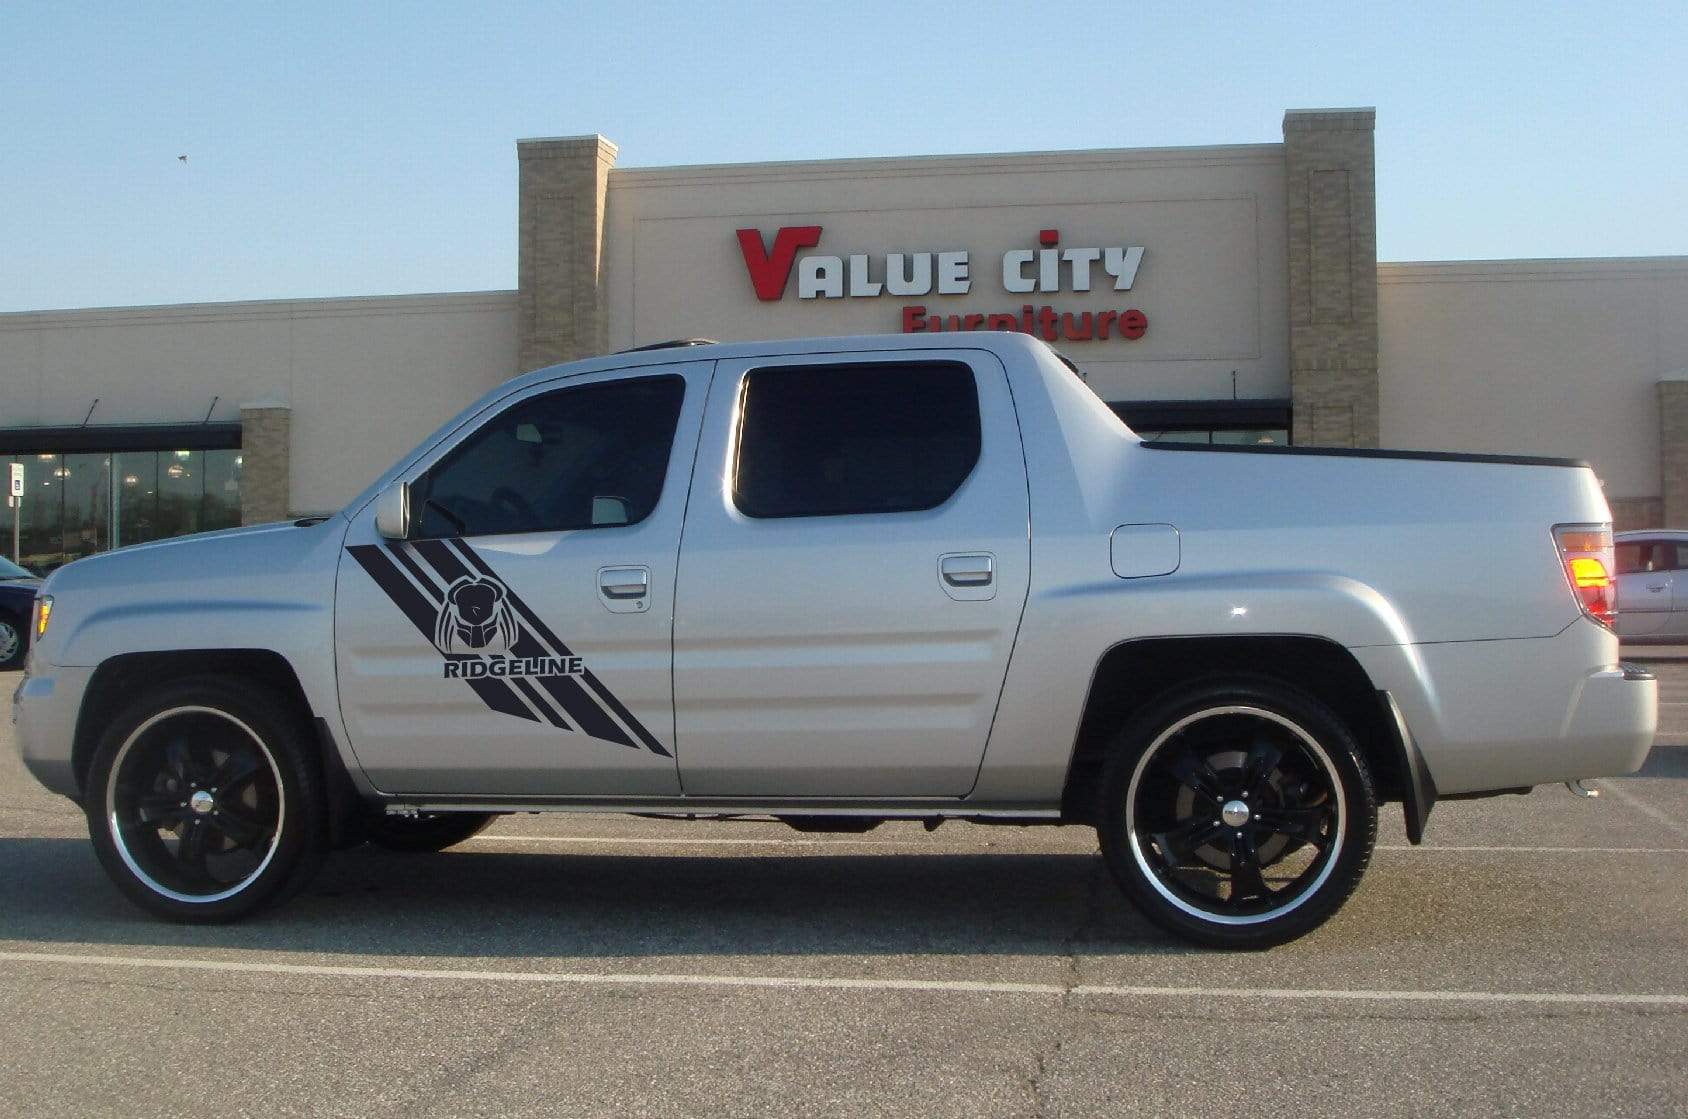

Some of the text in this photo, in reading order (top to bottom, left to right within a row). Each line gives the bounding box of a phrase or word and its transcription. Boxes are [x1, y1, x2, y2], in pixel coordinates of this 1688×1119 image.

[736, 226, 972, 300] VALUE
[902, 304, 1148, 341] Furniture
[443, 657, 583, 679] RIDGELINE
